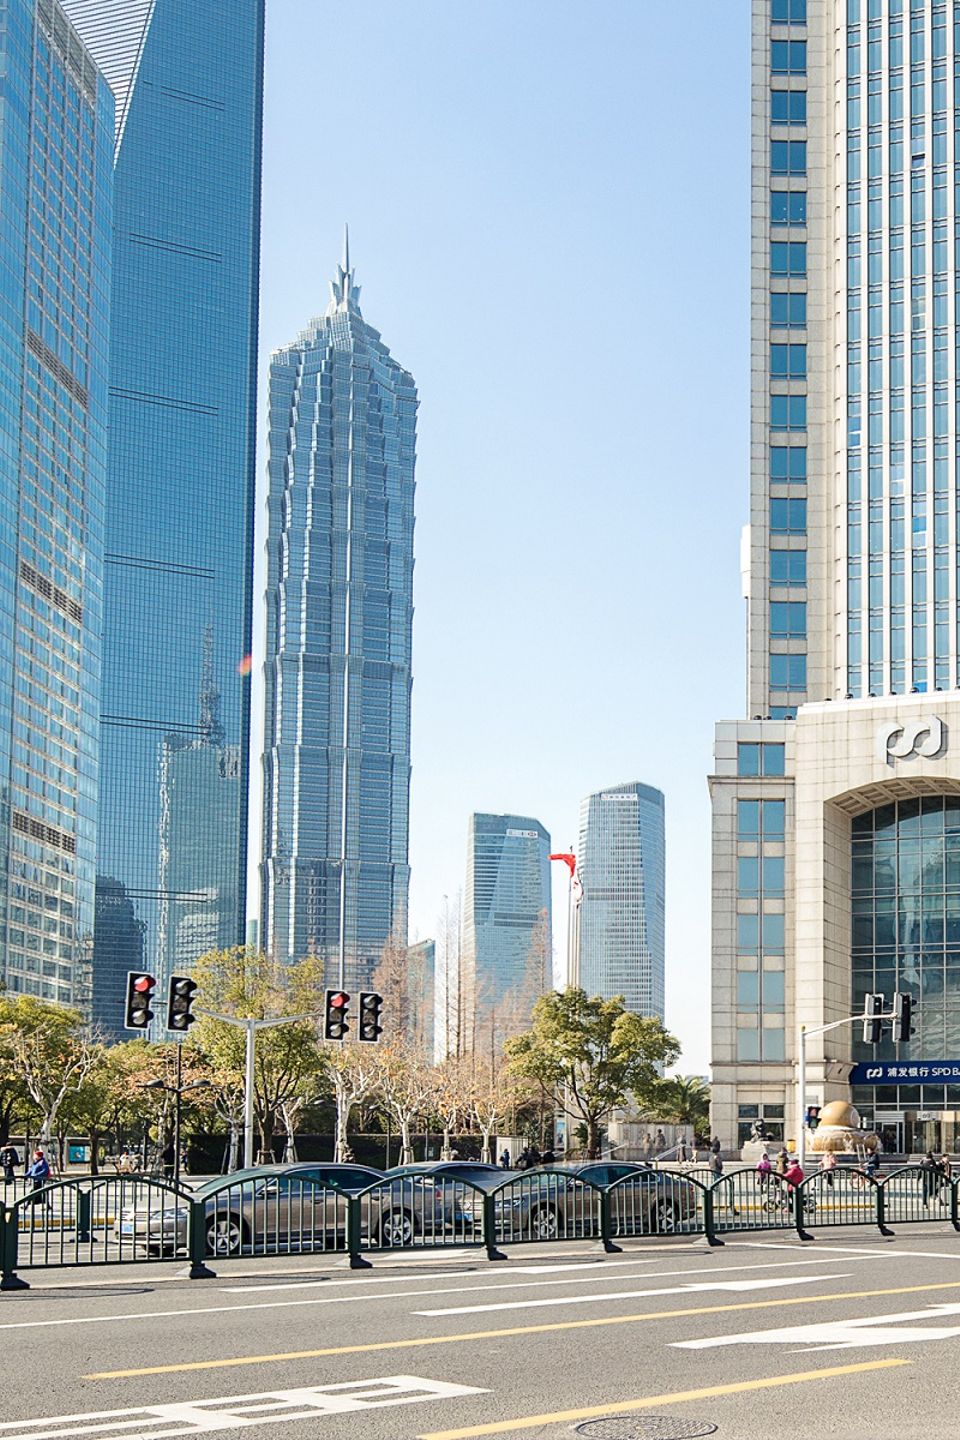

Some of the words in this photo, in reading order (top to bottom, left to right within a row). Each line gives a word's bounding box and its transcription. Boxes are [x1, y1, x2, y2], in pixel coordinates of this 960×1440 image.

[887, 1067, 930, 1077] 浦发银行
[931, 1067, 951, 1076] SPD
